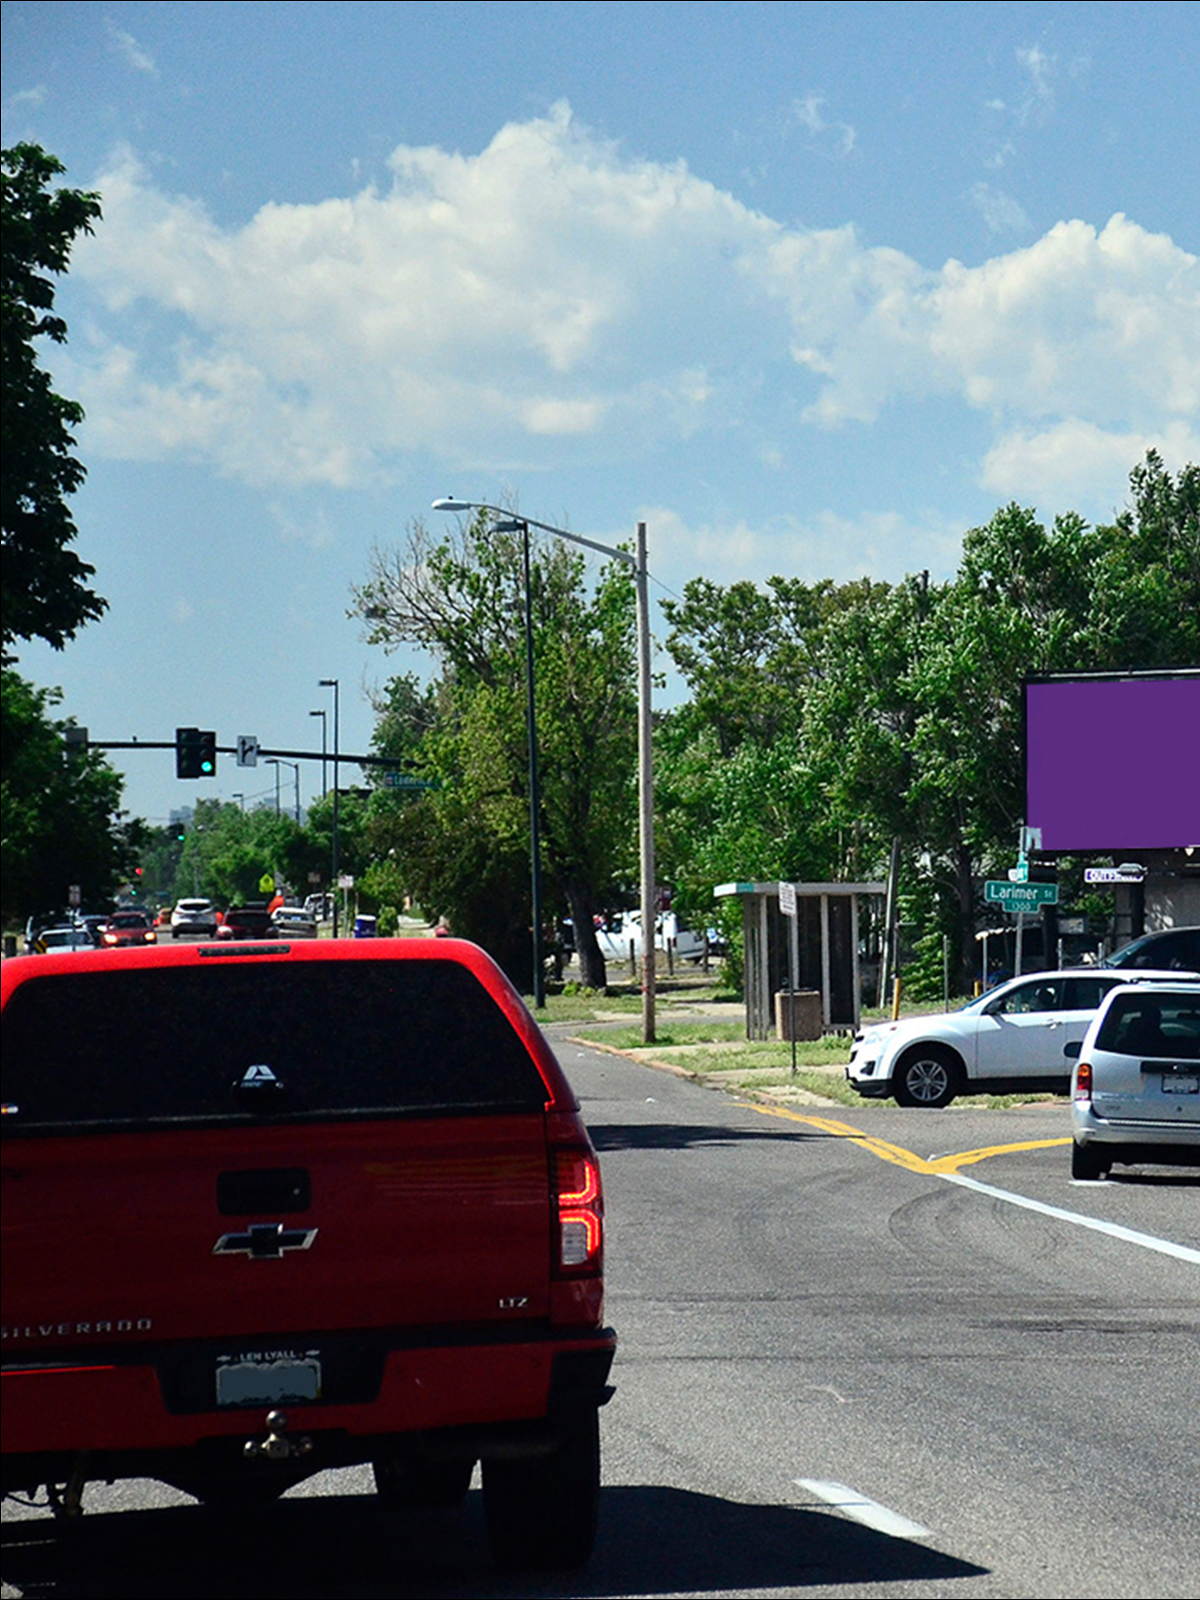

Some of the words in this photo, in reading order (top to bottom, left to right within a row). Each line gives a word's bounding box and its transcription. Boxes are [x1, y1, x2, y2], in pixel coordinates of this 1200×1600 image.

[991, 885, 1038, 900] Larimer
[499, 1297, 528, 1308] LTZ
[240, 1352, 262, 1361] LEN
[264, 1350, 296, 1360] LYALL
